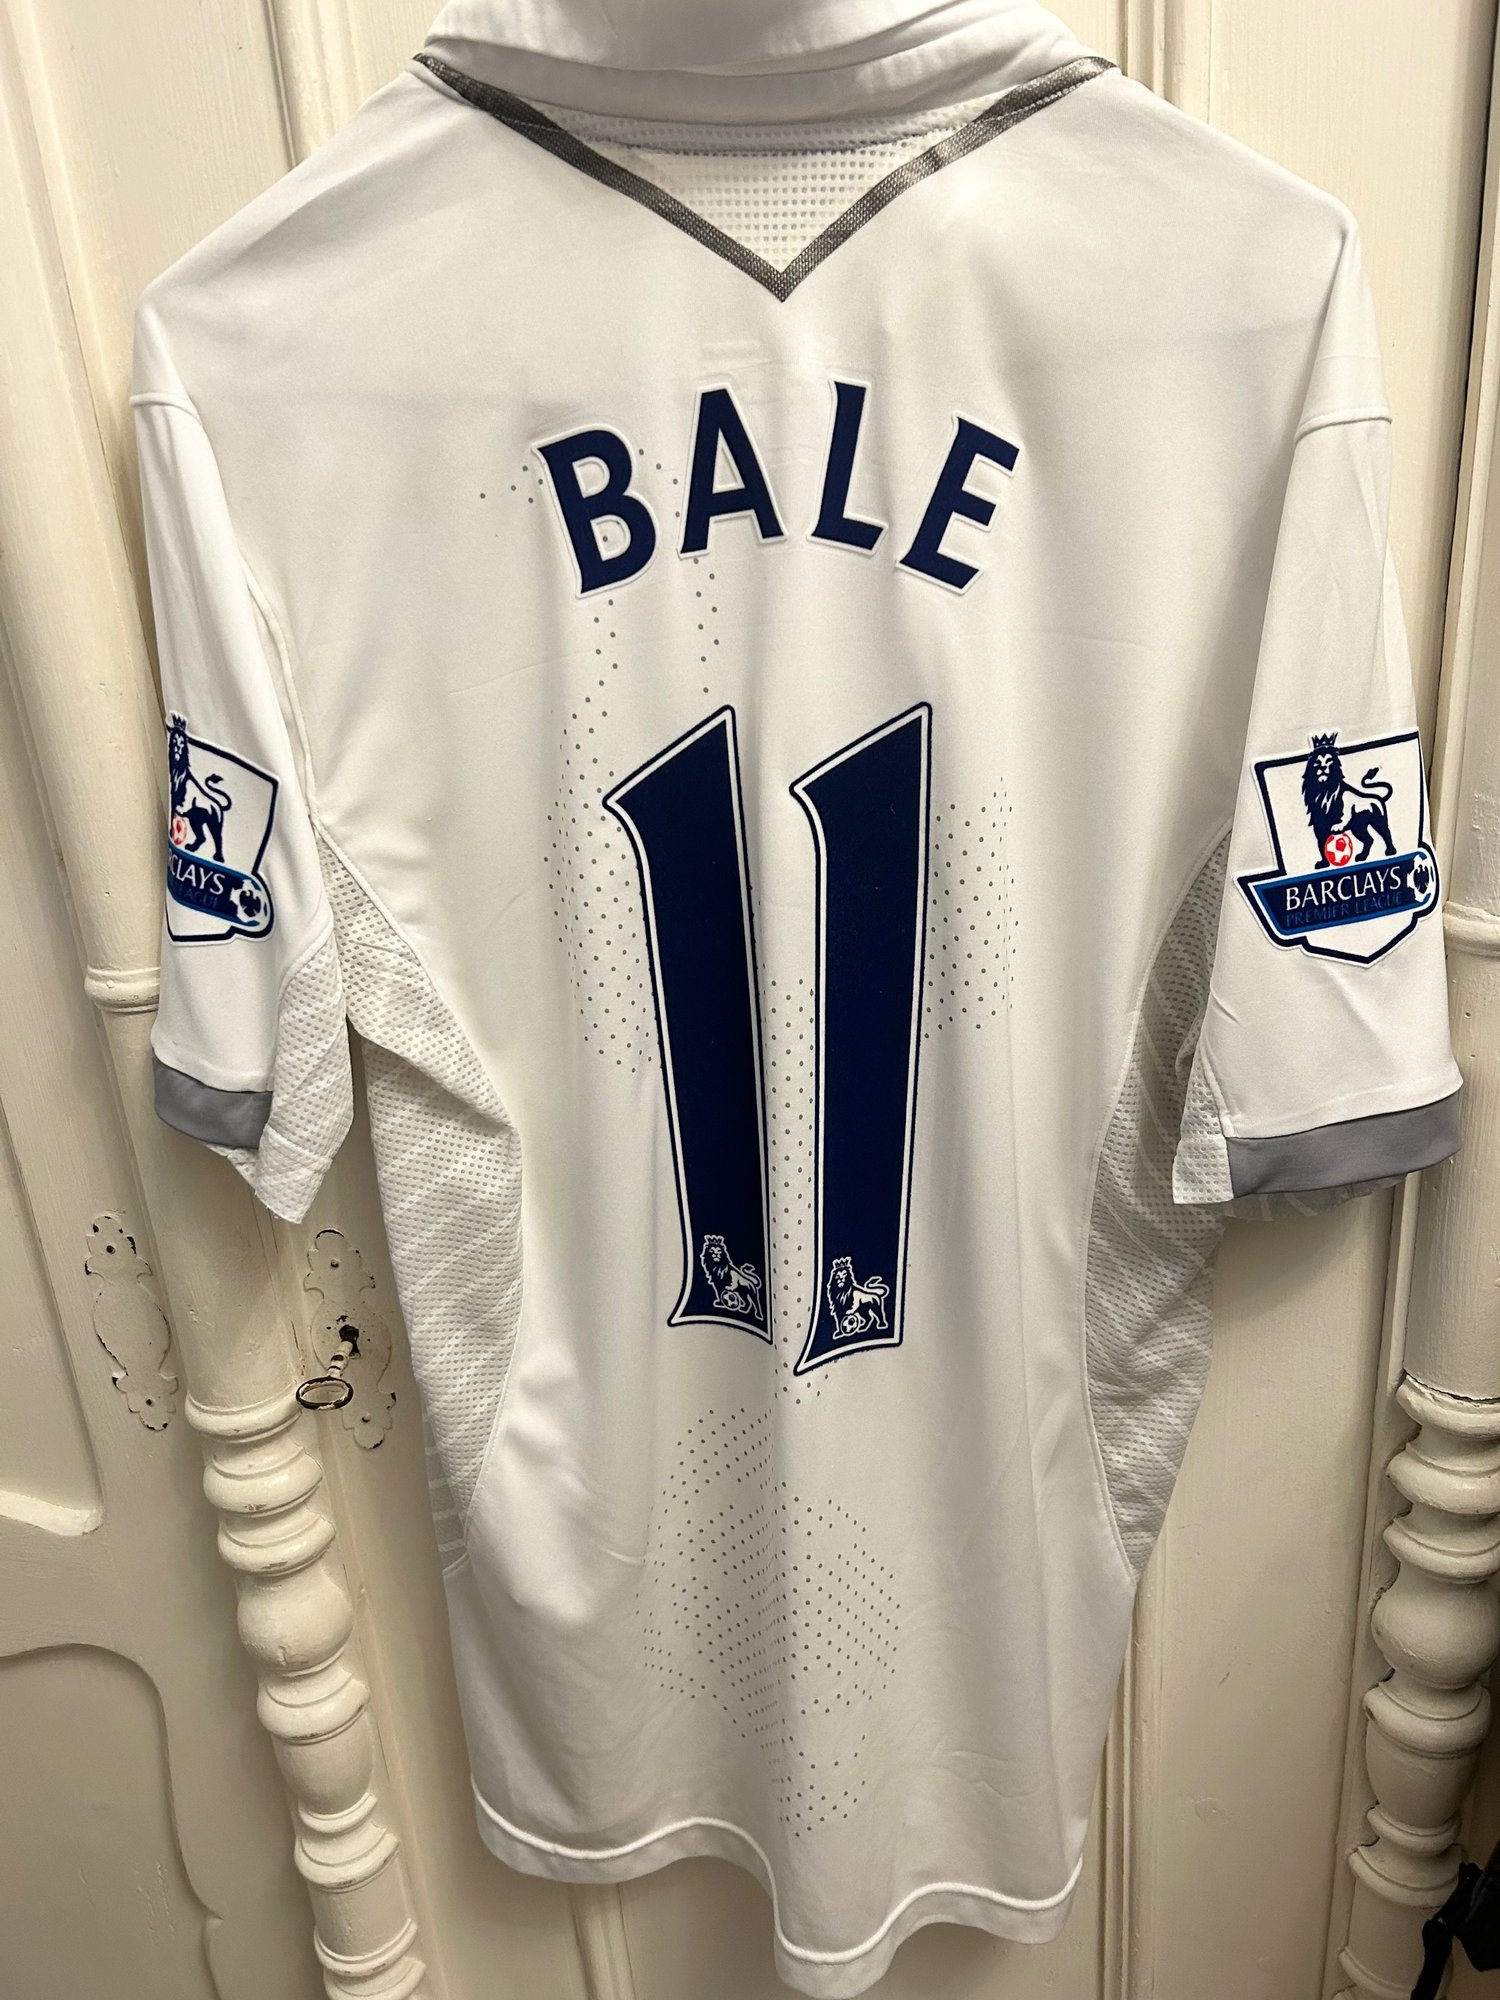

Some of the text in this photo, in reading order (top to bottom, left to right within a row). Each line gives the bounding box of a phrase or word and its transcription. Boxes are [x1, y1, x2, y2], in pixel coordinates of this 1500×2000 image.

[535, 379, 1022, 596] BALE
[1285, 865, 1402, 911] BARCLAYS
[1286, 891, 1403, 927] PREMIER LEAGUE
[603, 702, 932, 1375] 11
